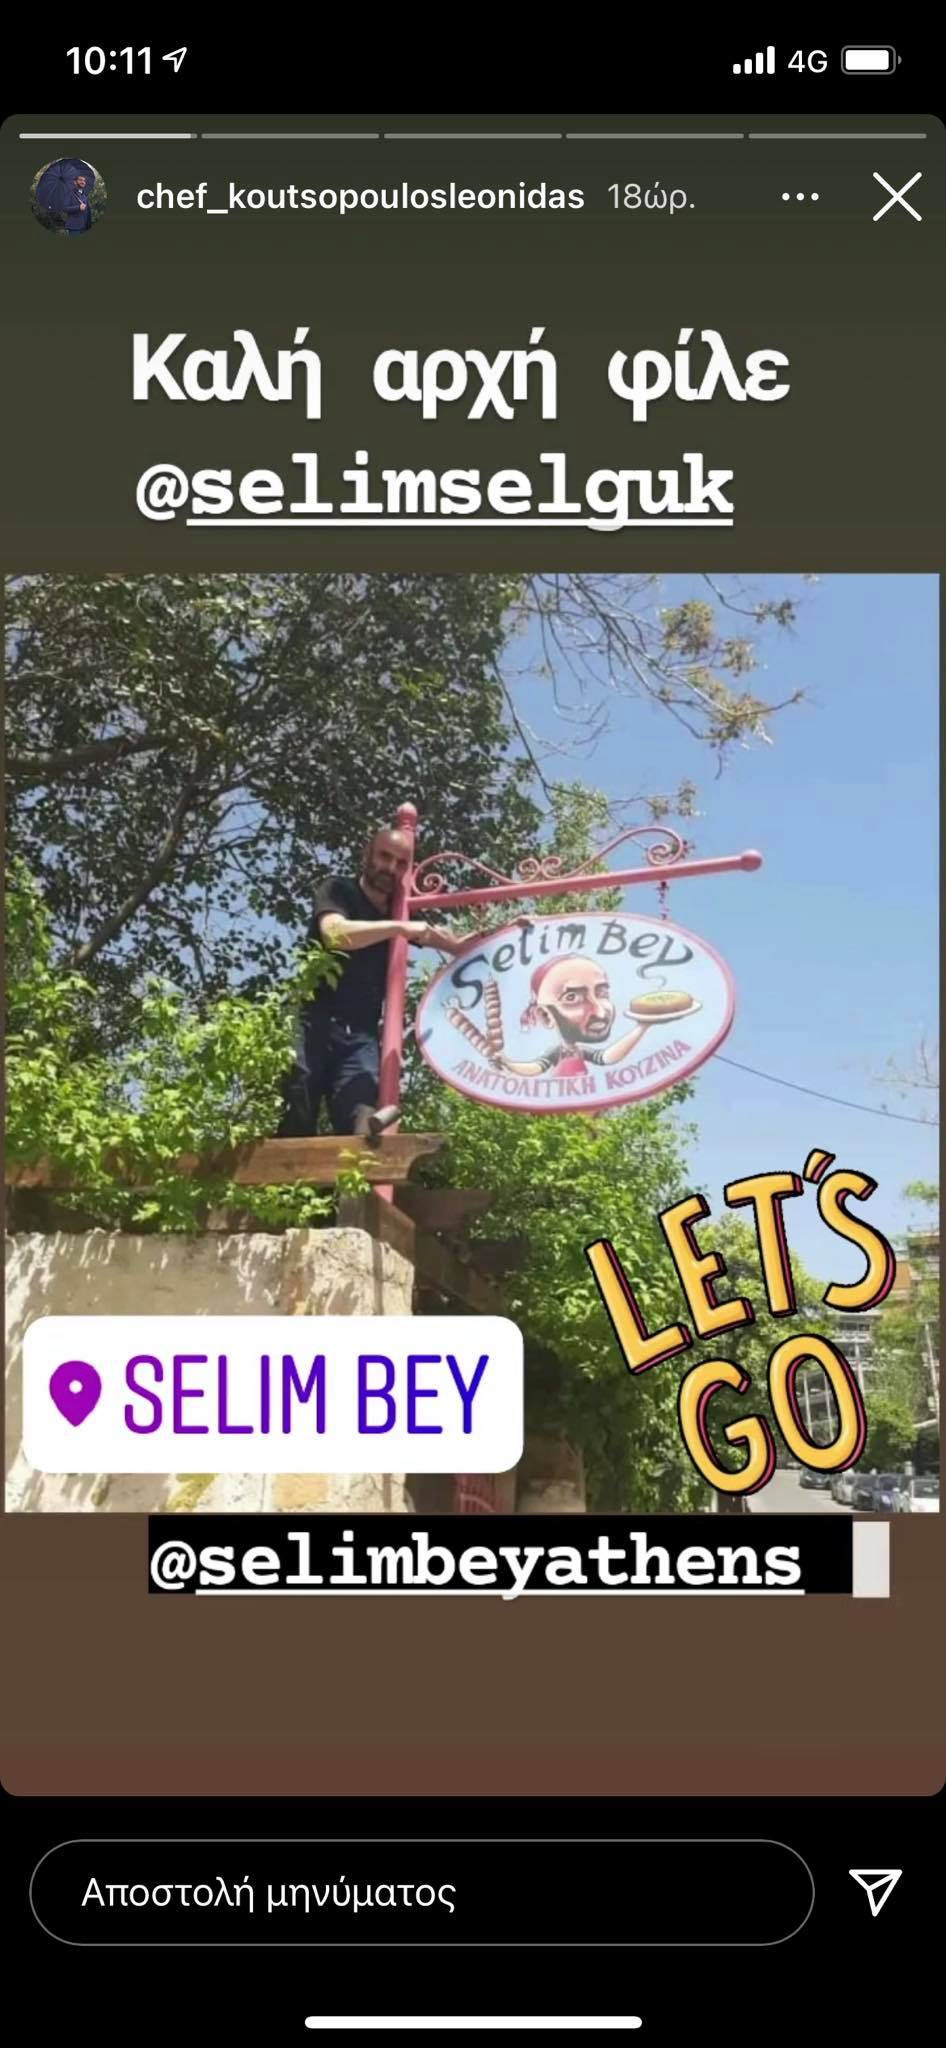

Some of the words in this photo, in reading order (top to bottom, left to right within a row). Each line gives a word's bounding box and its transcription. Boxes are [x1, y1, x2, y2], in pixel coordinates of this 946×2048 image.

[452, 922, 587, 1009] Selim
[597, 918, 694, 967] Bey
[605, 1039, 691, 1090] ΚΟΥΖΙΝΑ
